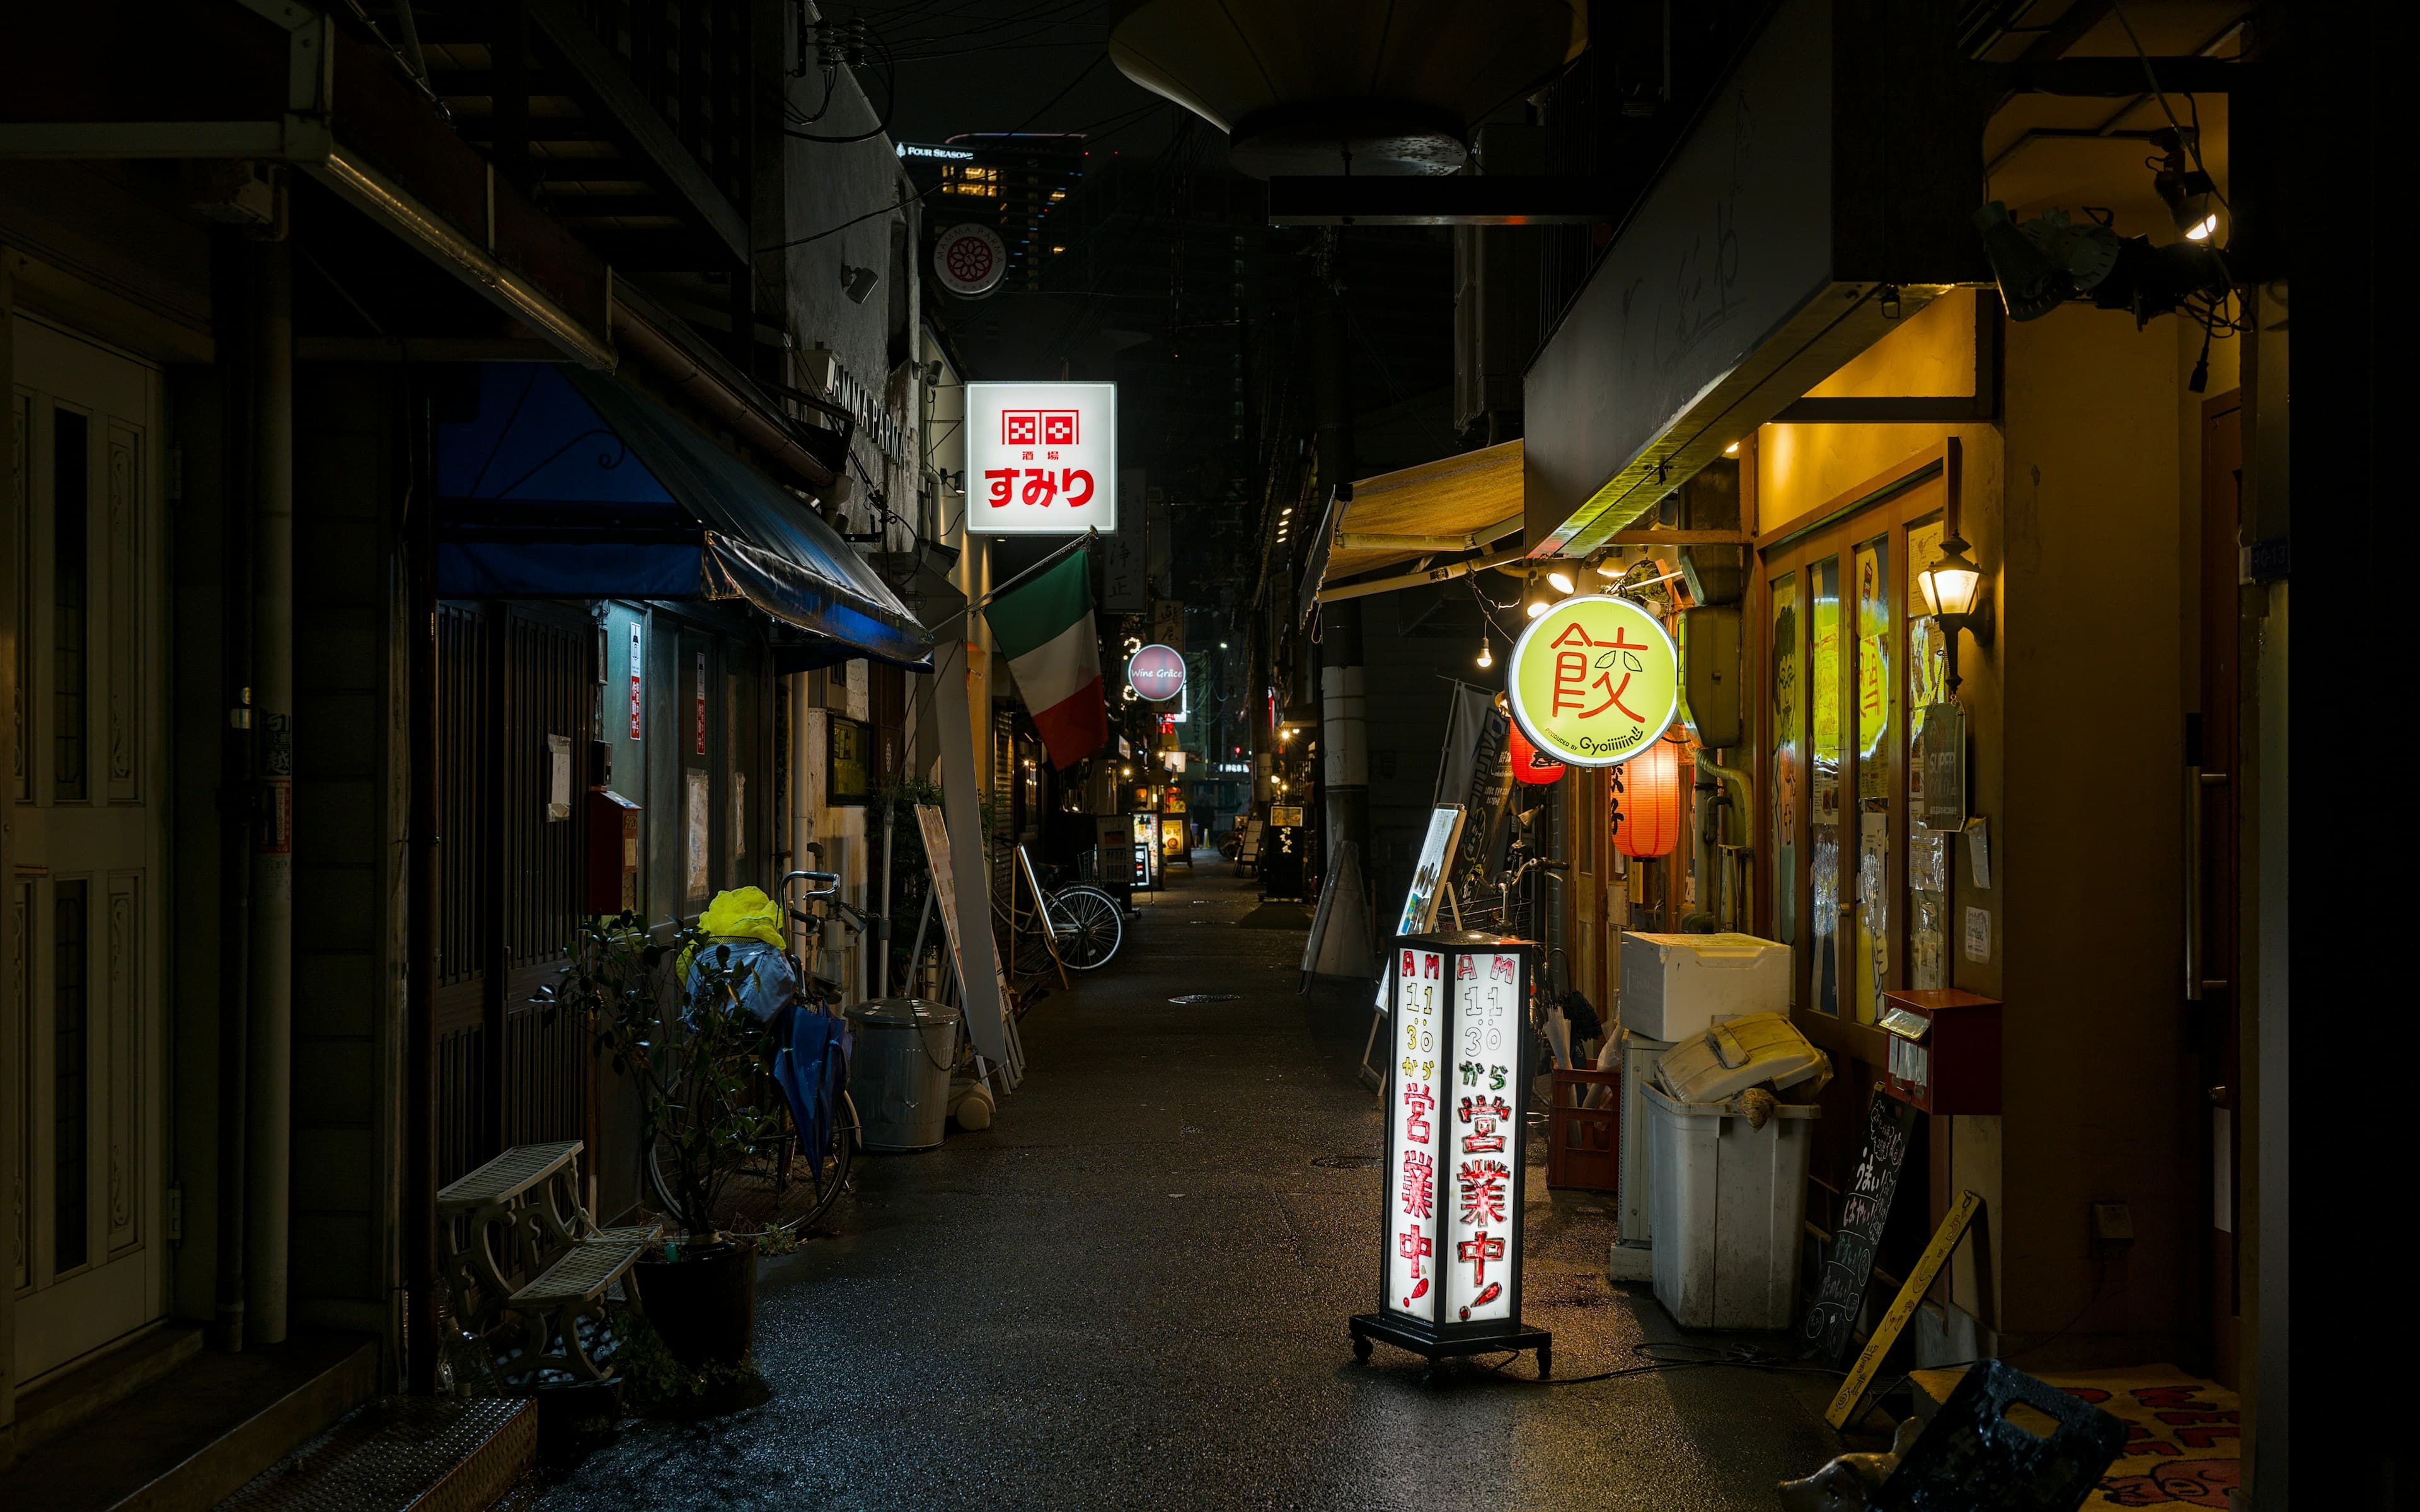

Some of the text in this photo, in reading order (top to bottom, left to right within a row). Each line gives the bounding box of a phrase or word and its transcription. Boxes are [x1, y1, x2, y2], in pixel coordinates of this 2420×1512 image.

[908, 146, 974, 159] FOUR SEASONS
[937, 226, 1003, 263] MAMMA PARMA
[832, 361, 905, 469] AMMA PARMA
[1022, 450, 1059, 461] 酒場
[984, 467, 1095, 508] すみり
[1131, 668, 1184, 678] Wine Grâce
[1551, 622, 1648, 723] 餃
[1545, 727, 1570, 747] PRODUCED
[1611, 763, 1624, 835] 子
[1402, 951, 1439, 980] AM
[1457, 953, 1516, 985] AM
[1402, 1057, 1434, 1081] から
[1459, 1060, 1509, 1090] から
[1855, 1146, 1887, 1192] うまい!
